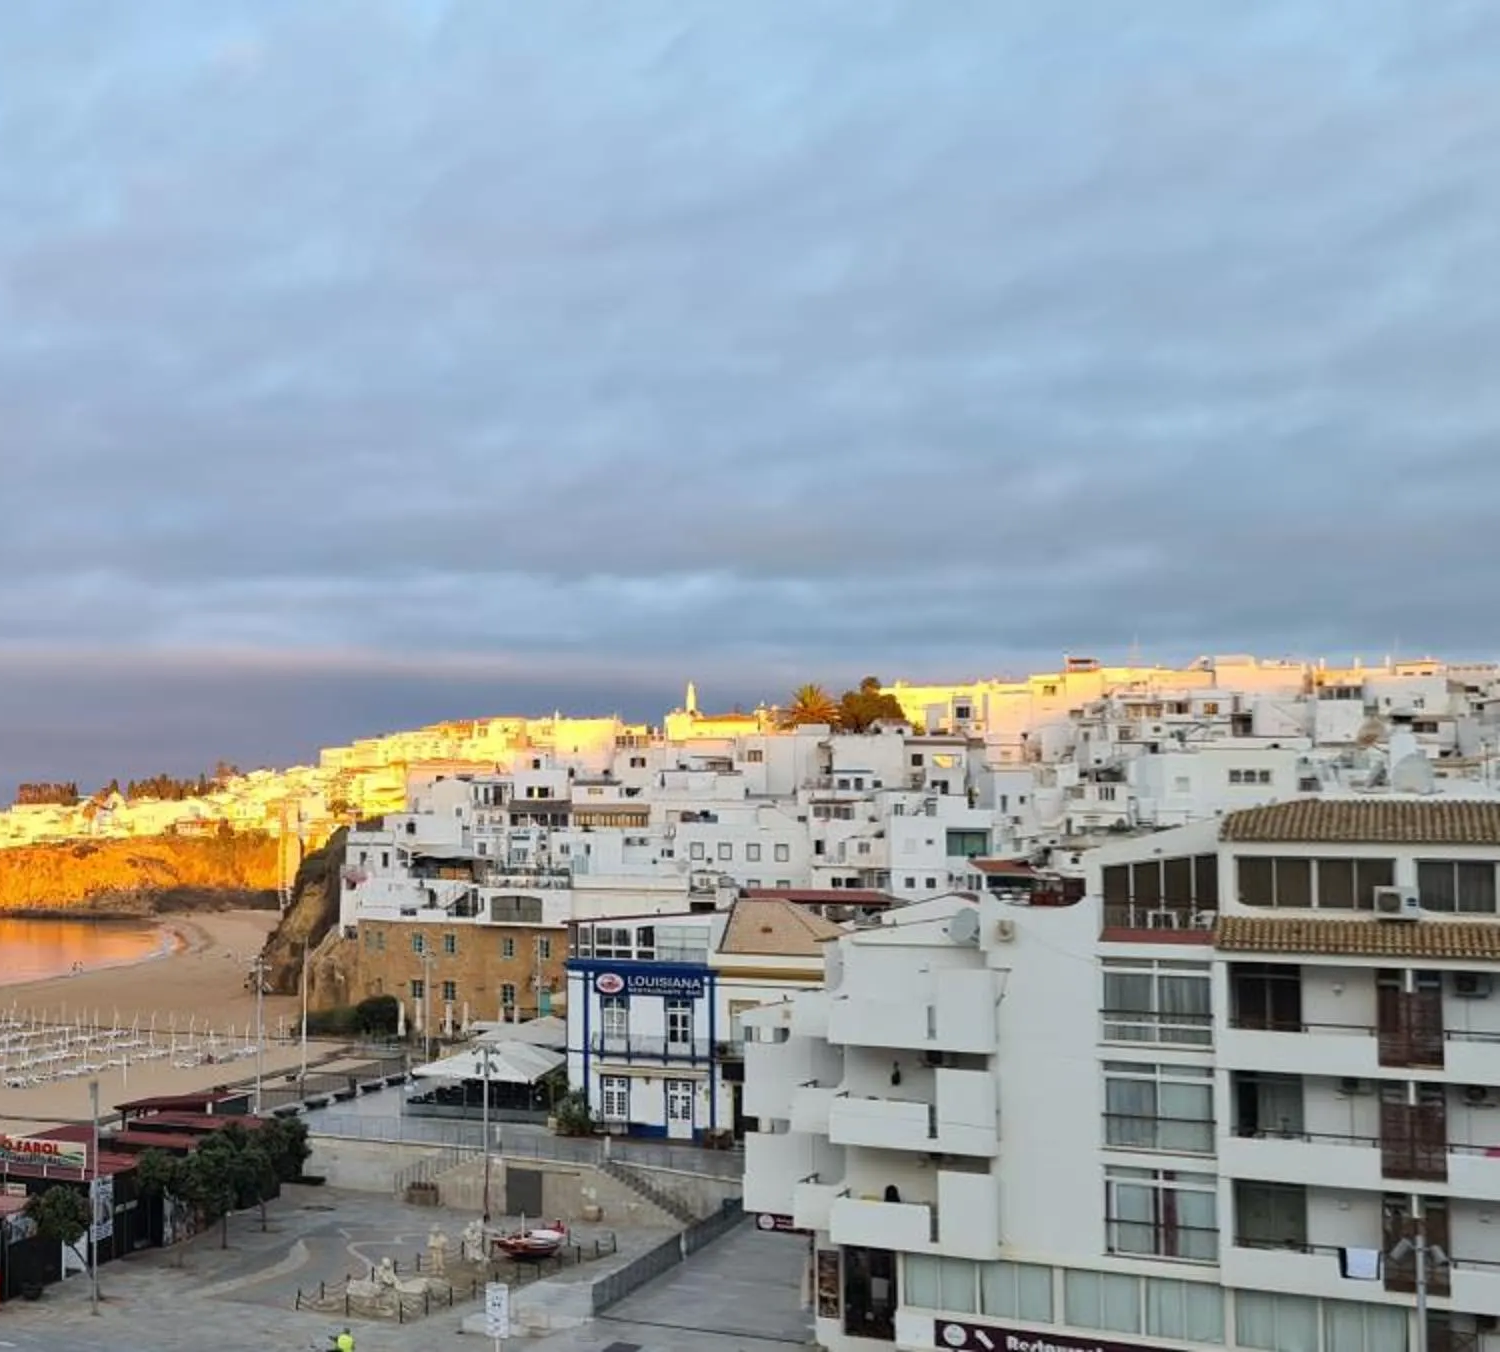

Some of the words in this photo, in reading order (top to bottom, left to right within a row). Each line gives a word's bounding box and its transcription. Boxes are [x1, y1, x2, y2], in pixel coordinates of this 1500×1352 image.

[627, 975, 701, 988] LOUISIANA
[16, 1140, 61, 1155] FAROL
[1006, 1335, 1104, 1352] Restau
